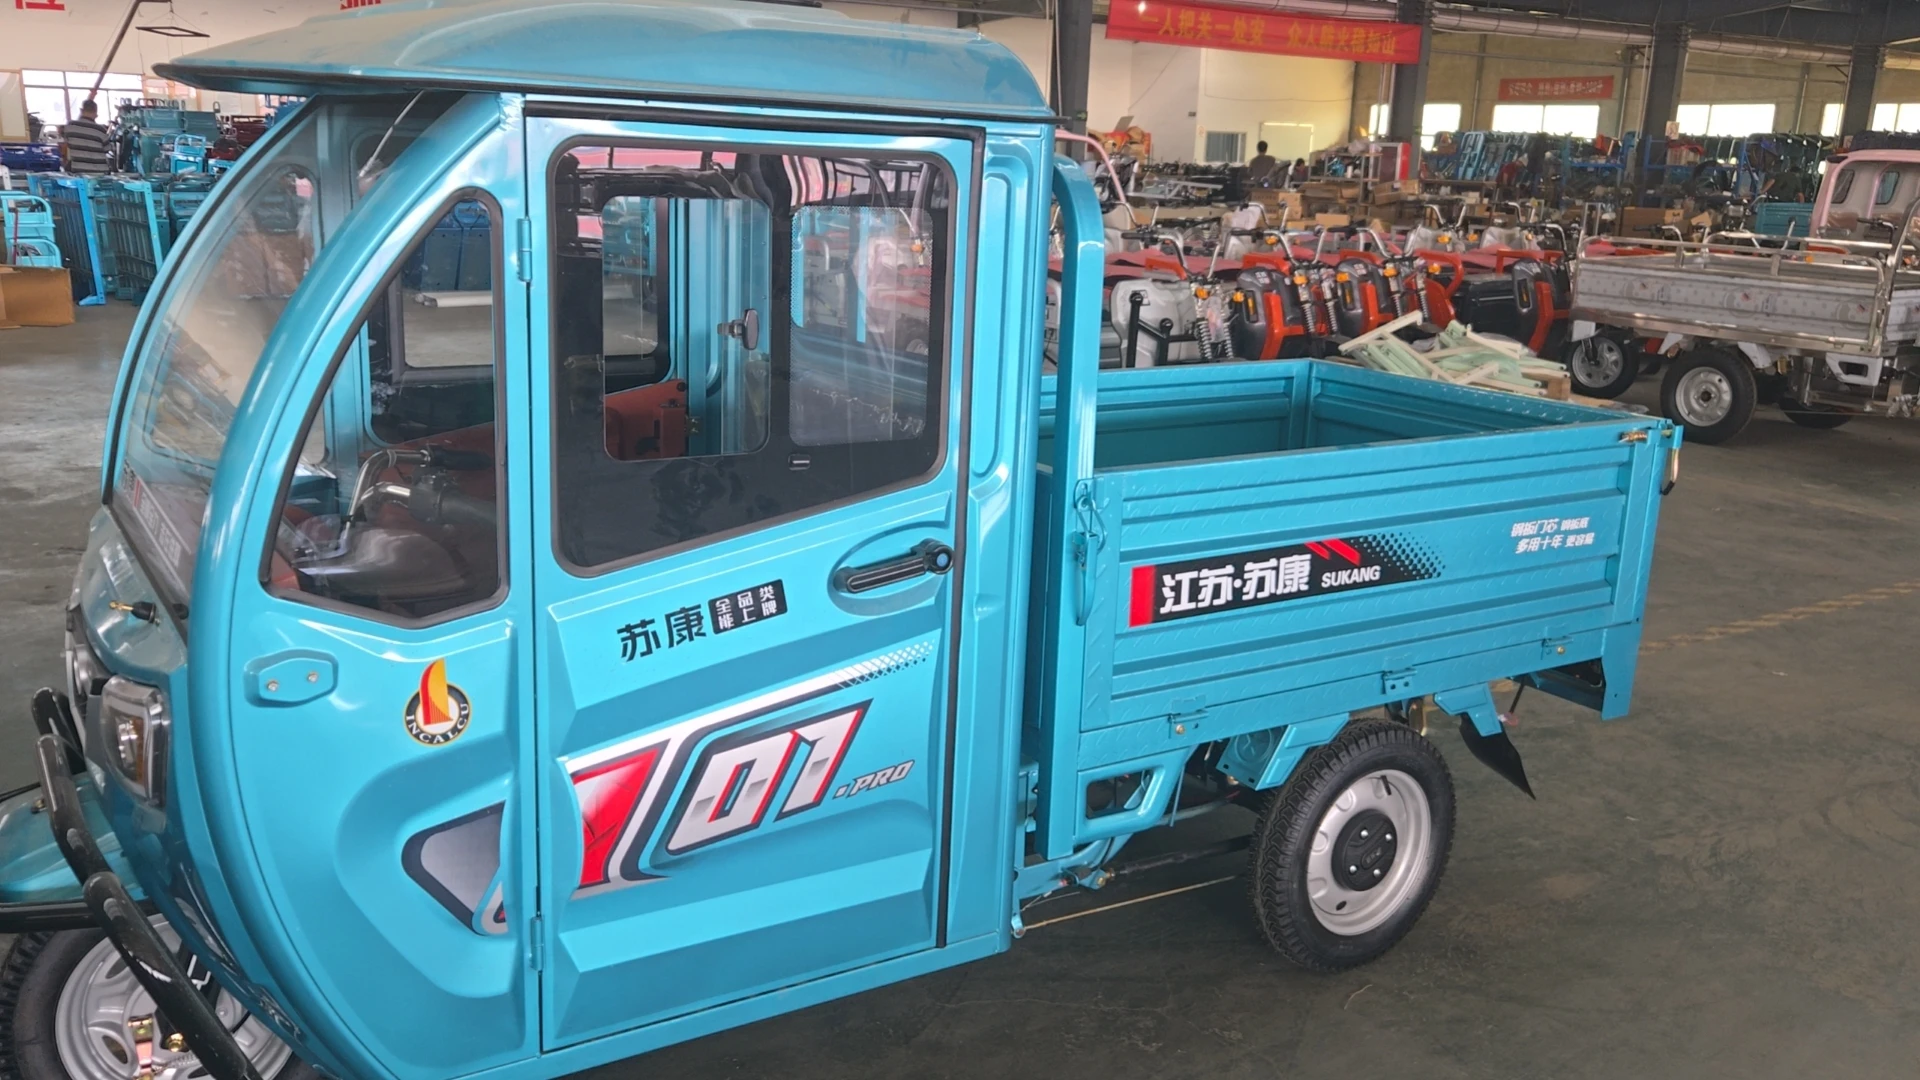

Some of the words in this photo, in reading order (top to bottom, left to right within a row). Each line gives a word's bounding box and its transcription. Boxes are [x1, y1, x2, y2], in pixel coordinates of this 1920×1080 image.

[1515, 534, 1564, 554] 多用十年
[1321, 565, 1381, 588] SUKANG
[617, 604, 706, 662] 苏康
